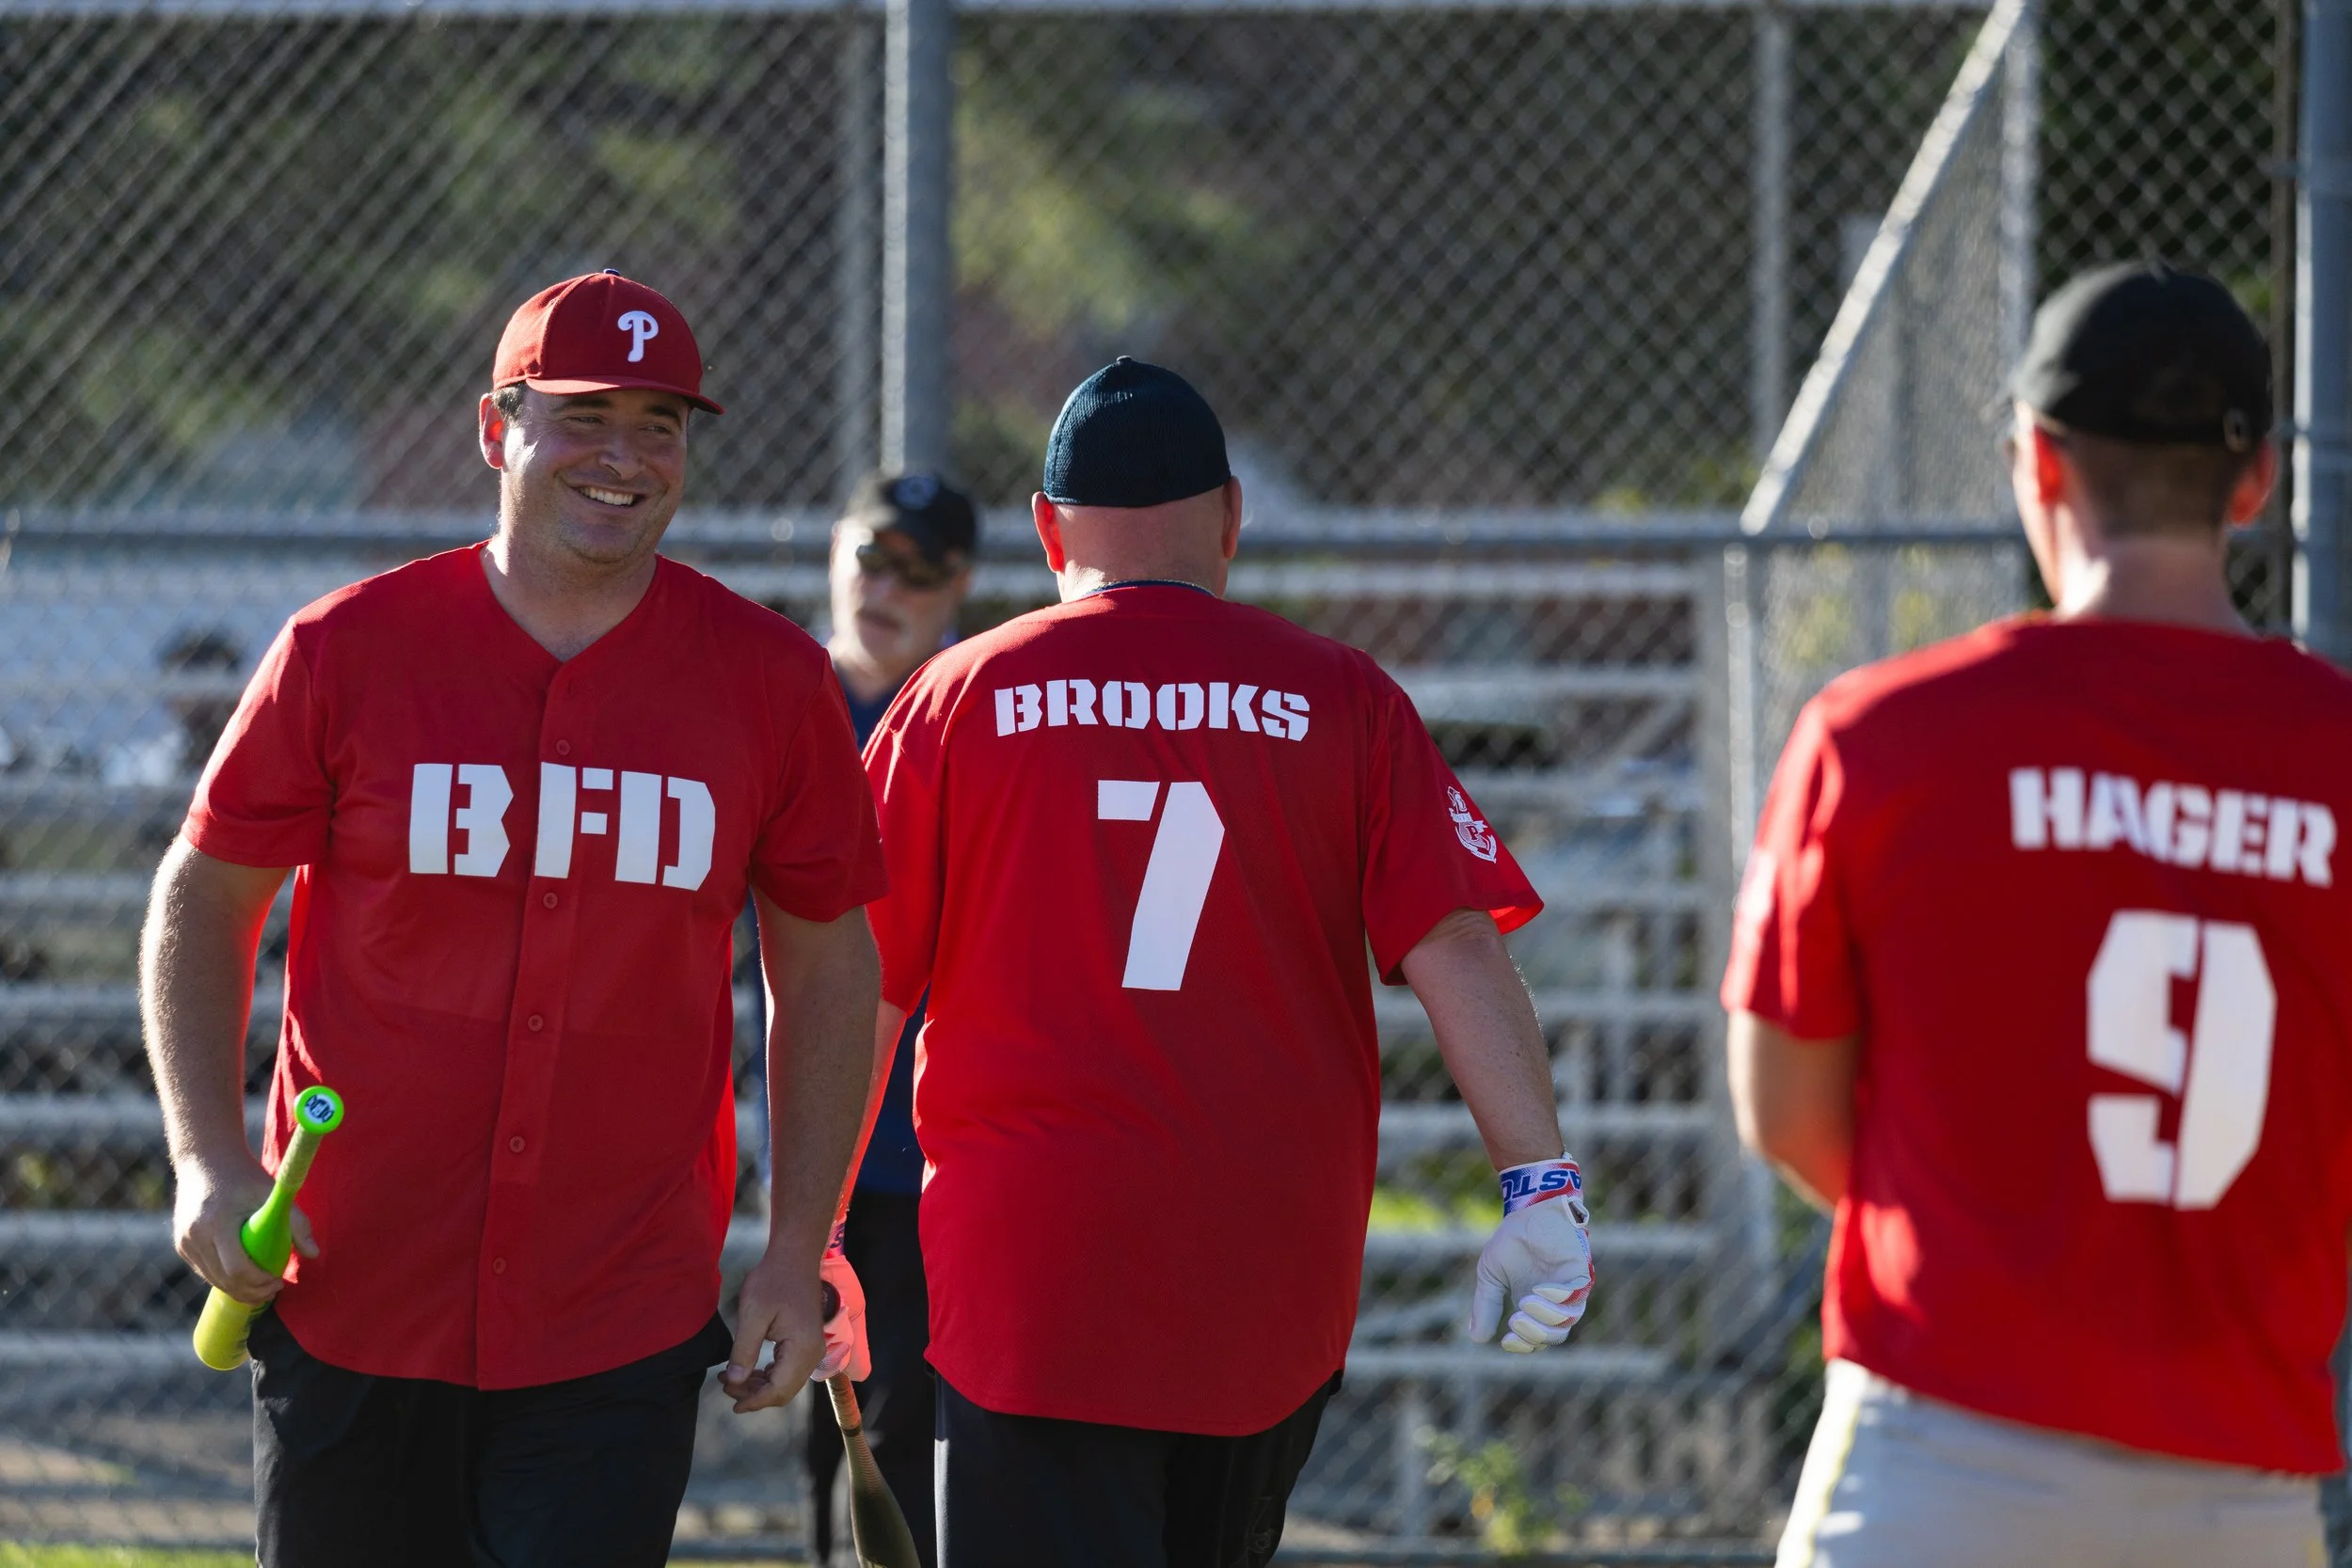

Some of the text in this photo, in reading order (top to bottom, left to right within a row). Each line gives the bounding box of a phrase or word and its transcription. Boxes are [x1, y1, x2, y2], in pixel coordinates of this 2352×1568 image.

[617, 310, 659, 362] P
[994, 678, 1311, 742] BROOKS
[408, 761, 716, 892] BFD
[1097, 779, 1226, 991] 7
[2010, 768, 2337, 886] HAGER
[2087, 911, 2277, 1209] 9
